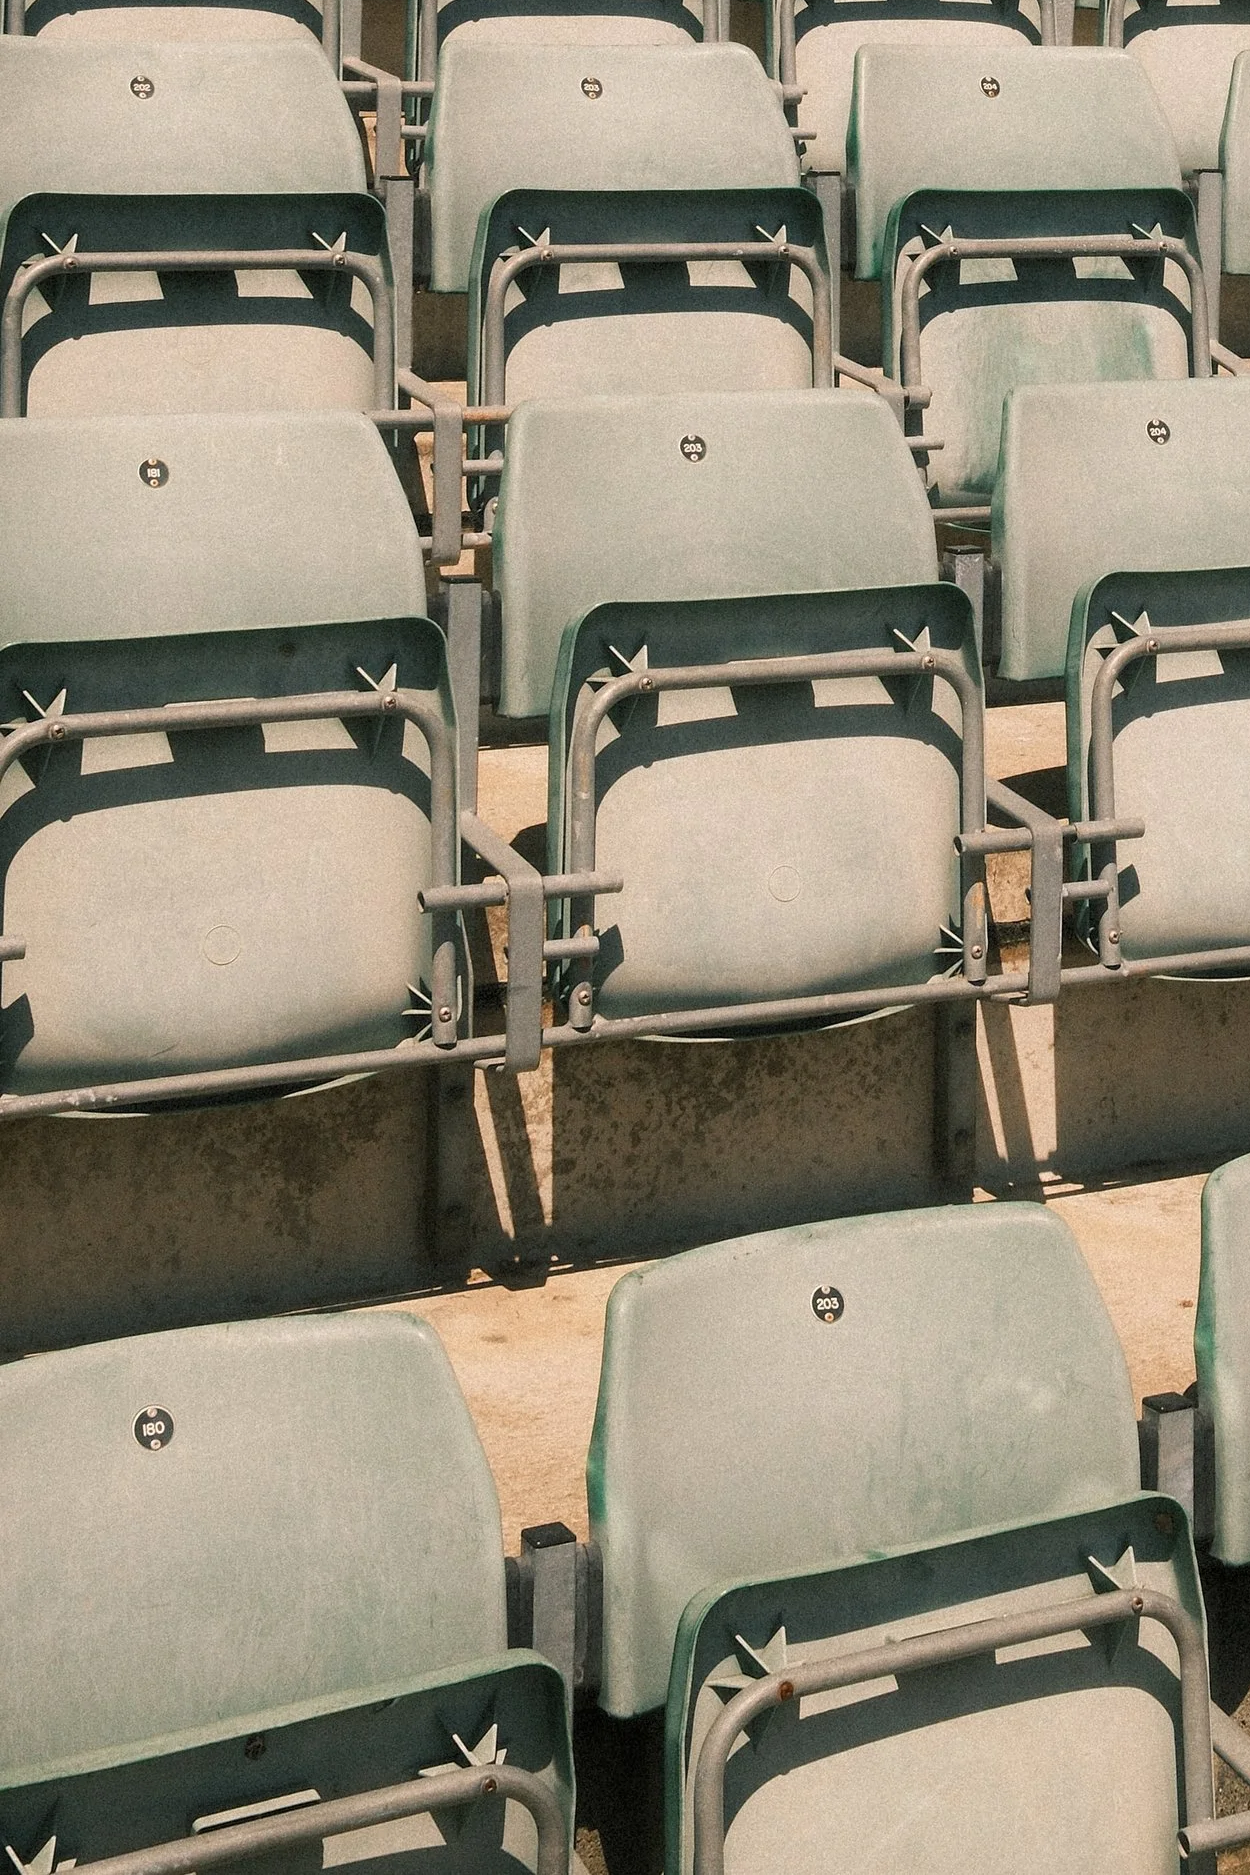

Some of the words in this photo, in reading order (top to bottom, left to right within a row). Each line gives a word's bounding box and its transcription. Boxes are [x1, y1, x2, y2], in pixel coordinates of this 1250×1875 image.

[133, 83, 151, 92] 202
[583, 83, 600, 92] 203
[982, 82, 998, 91] 204
[1149, 427, 1167, 436] 204
[683, 443, 703, 453] 203
[147, 468, 161, 478] 181
[816, 1297, 840, 1310] 203
[142, 1421, 165, 1437] 180
